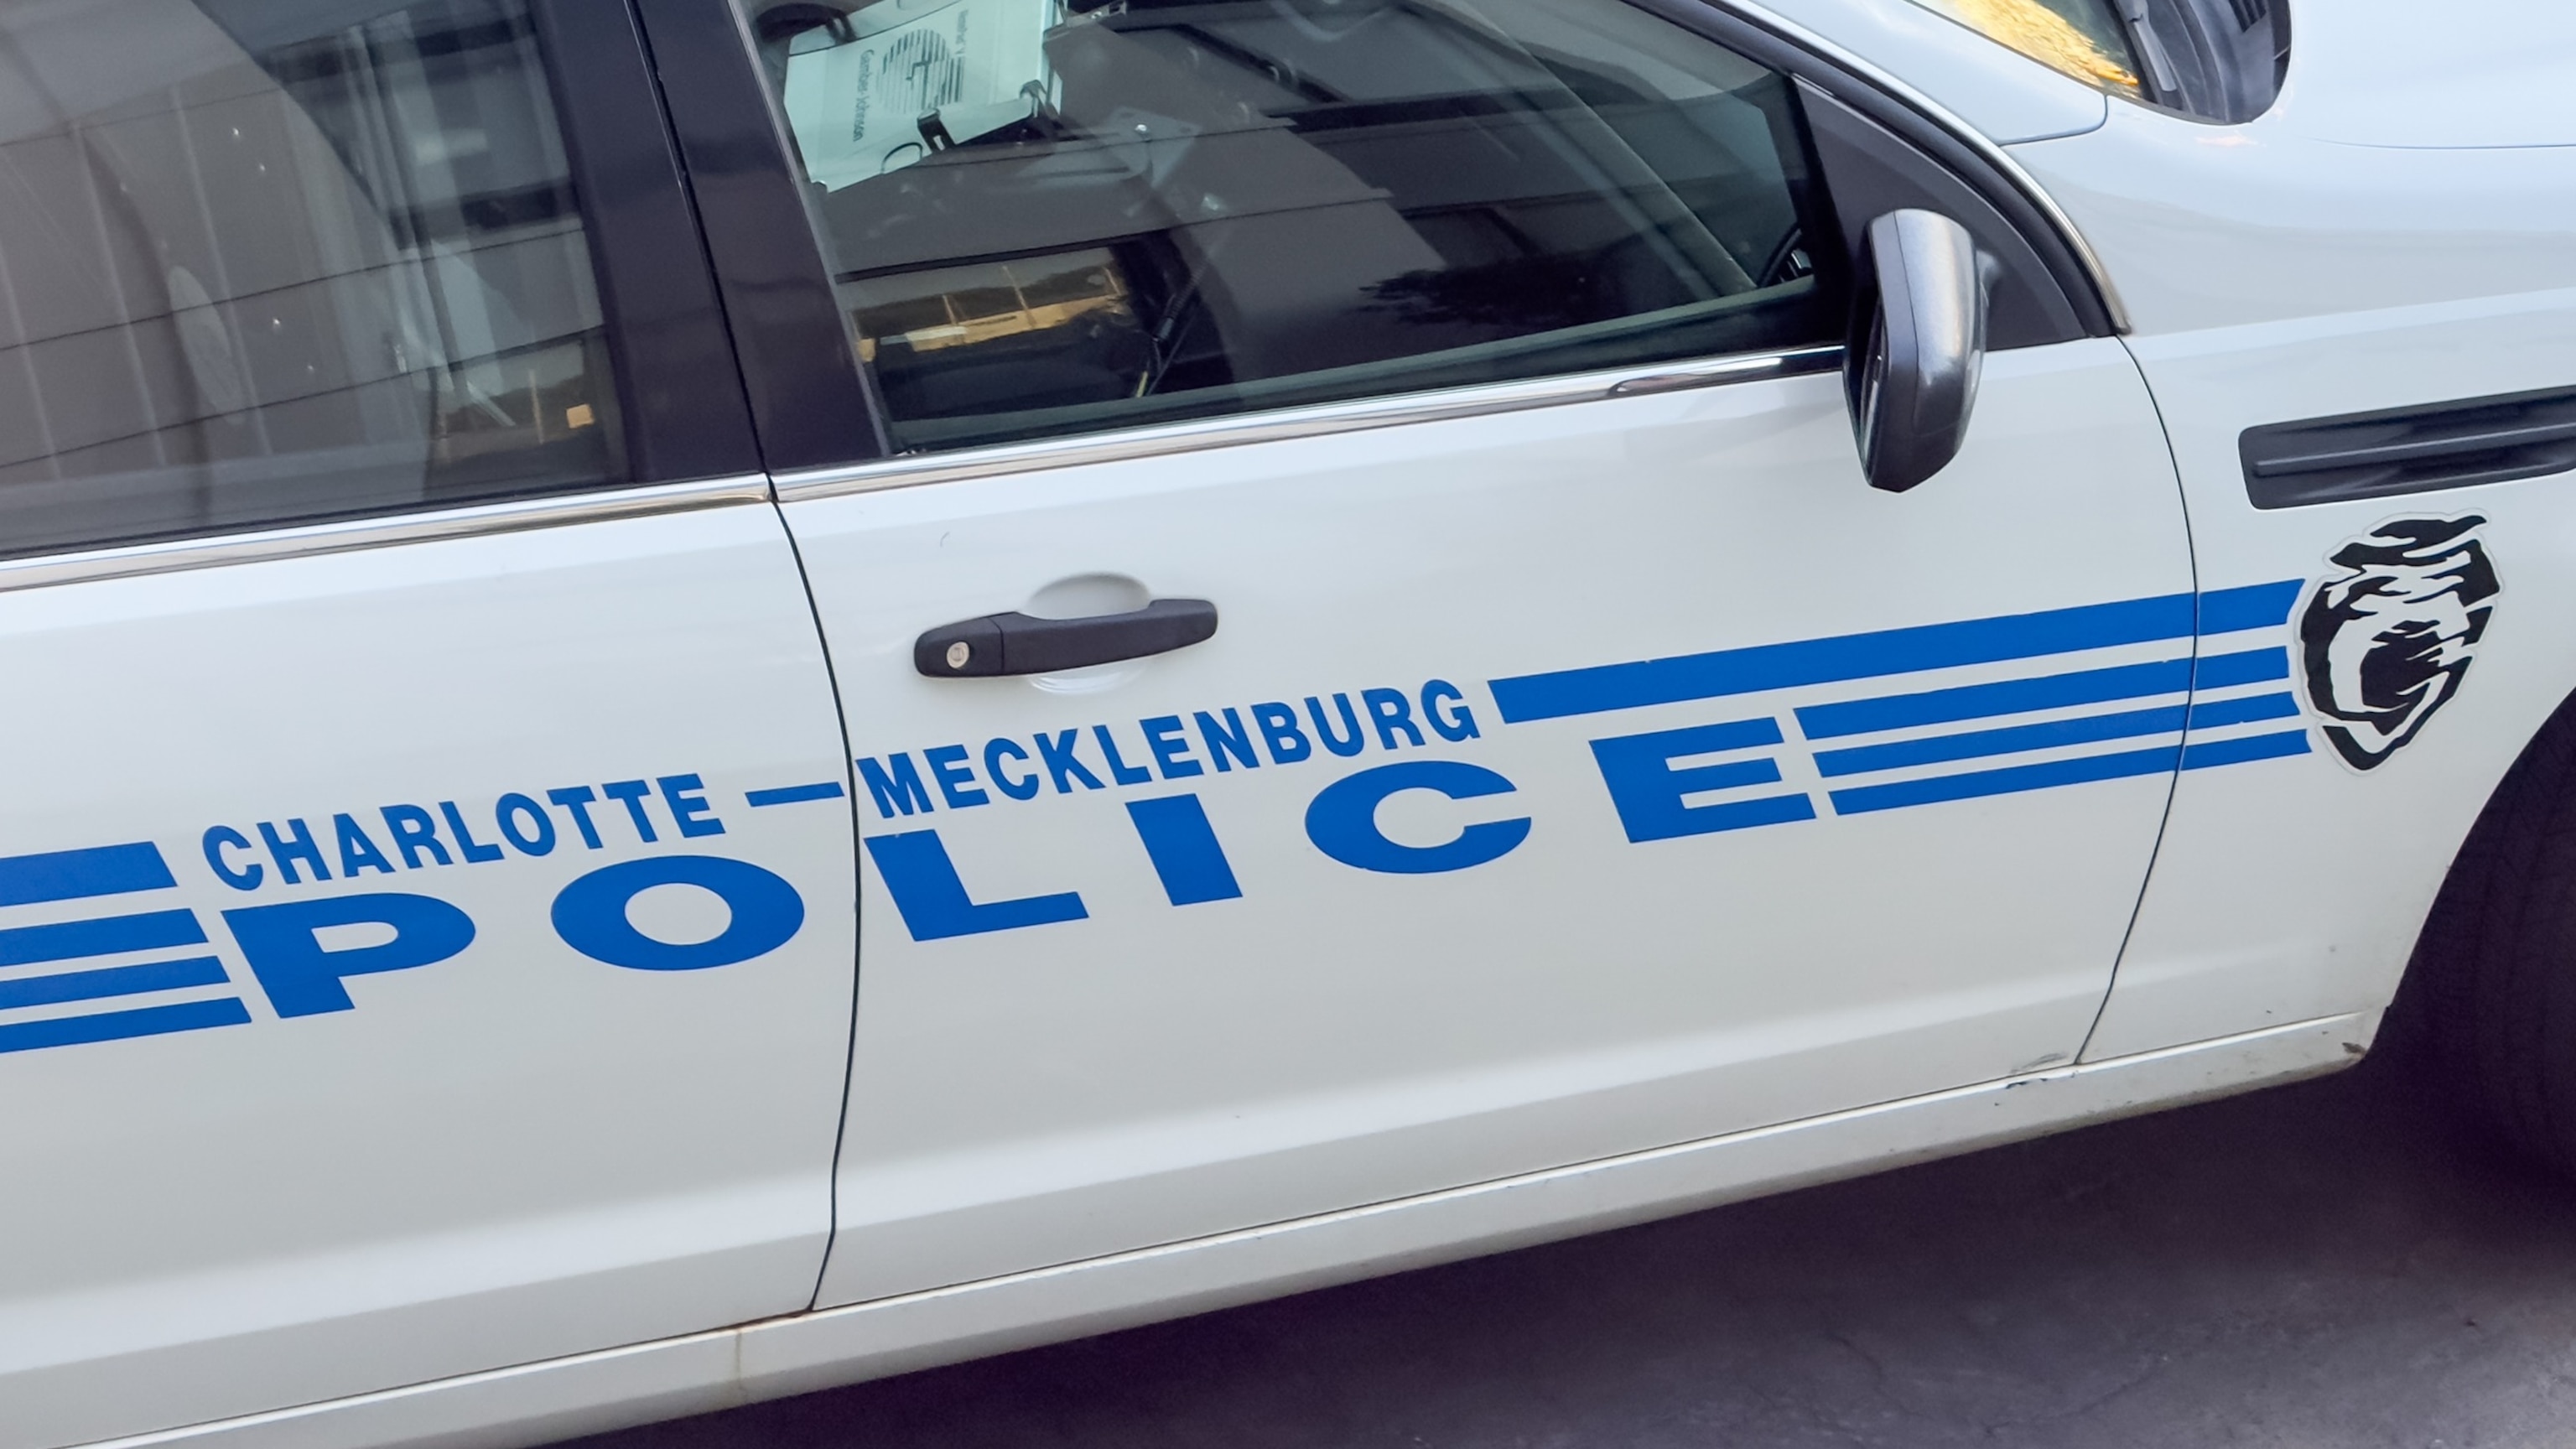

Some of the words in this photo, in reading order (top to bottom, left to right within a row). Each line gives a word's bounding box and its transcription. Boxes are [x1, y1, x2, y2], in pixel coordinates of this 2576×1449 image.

[202, 773, 725, 892] CHARLOTTE
[857, 679, 1481, 819] MECKLENBURG
[221, 716, 1817, 1020] POLICE
